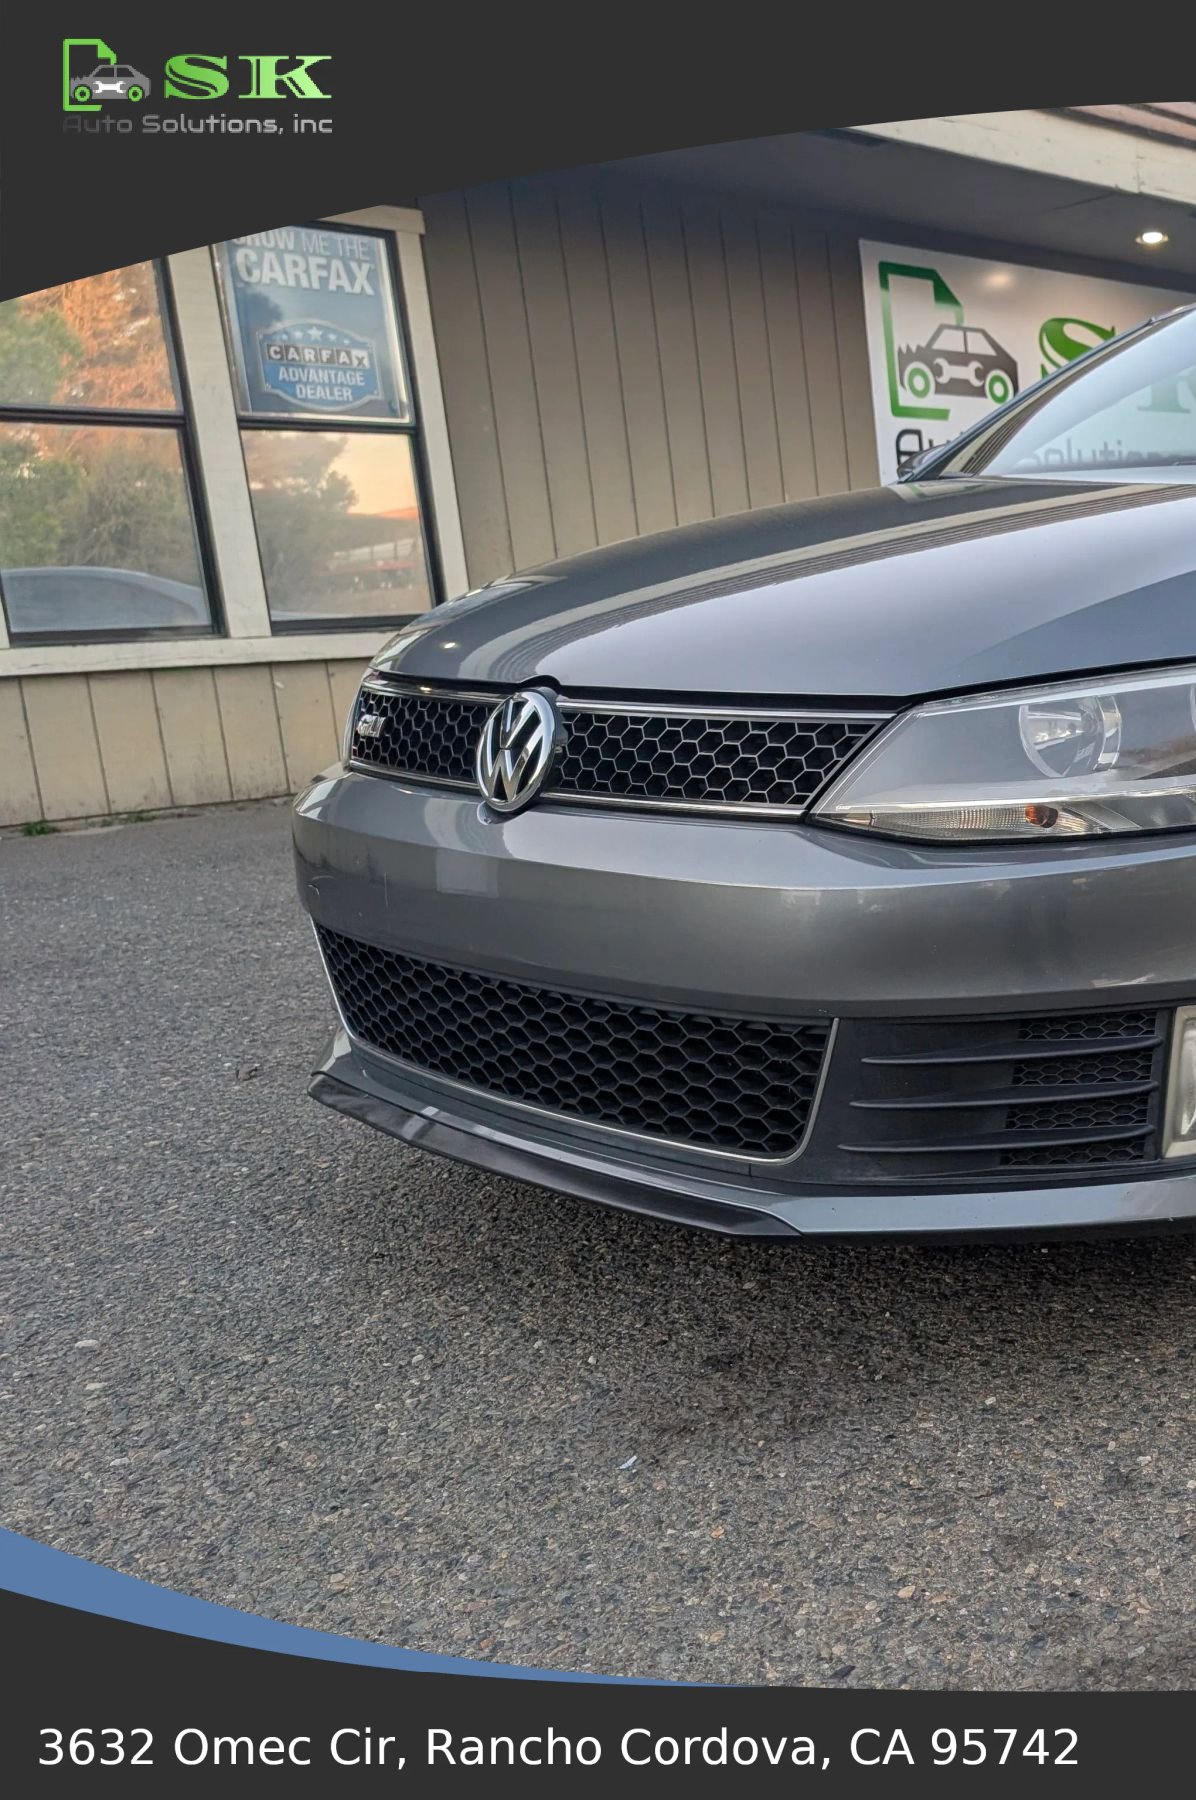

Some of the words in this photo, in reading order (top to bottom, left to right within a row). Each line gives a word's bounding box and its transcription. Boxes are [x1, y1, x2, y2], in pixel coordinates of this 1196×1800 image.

[303, 233, 330, 255] ME
[337, 237, 370, 260] THE
[236, 248, 374, 295] CARFAX
[269, 347, 367, 367] CARFAX
[279, 367, 365, 386] ADVANTAGE
[296, 384, 353, 401] DEALER
